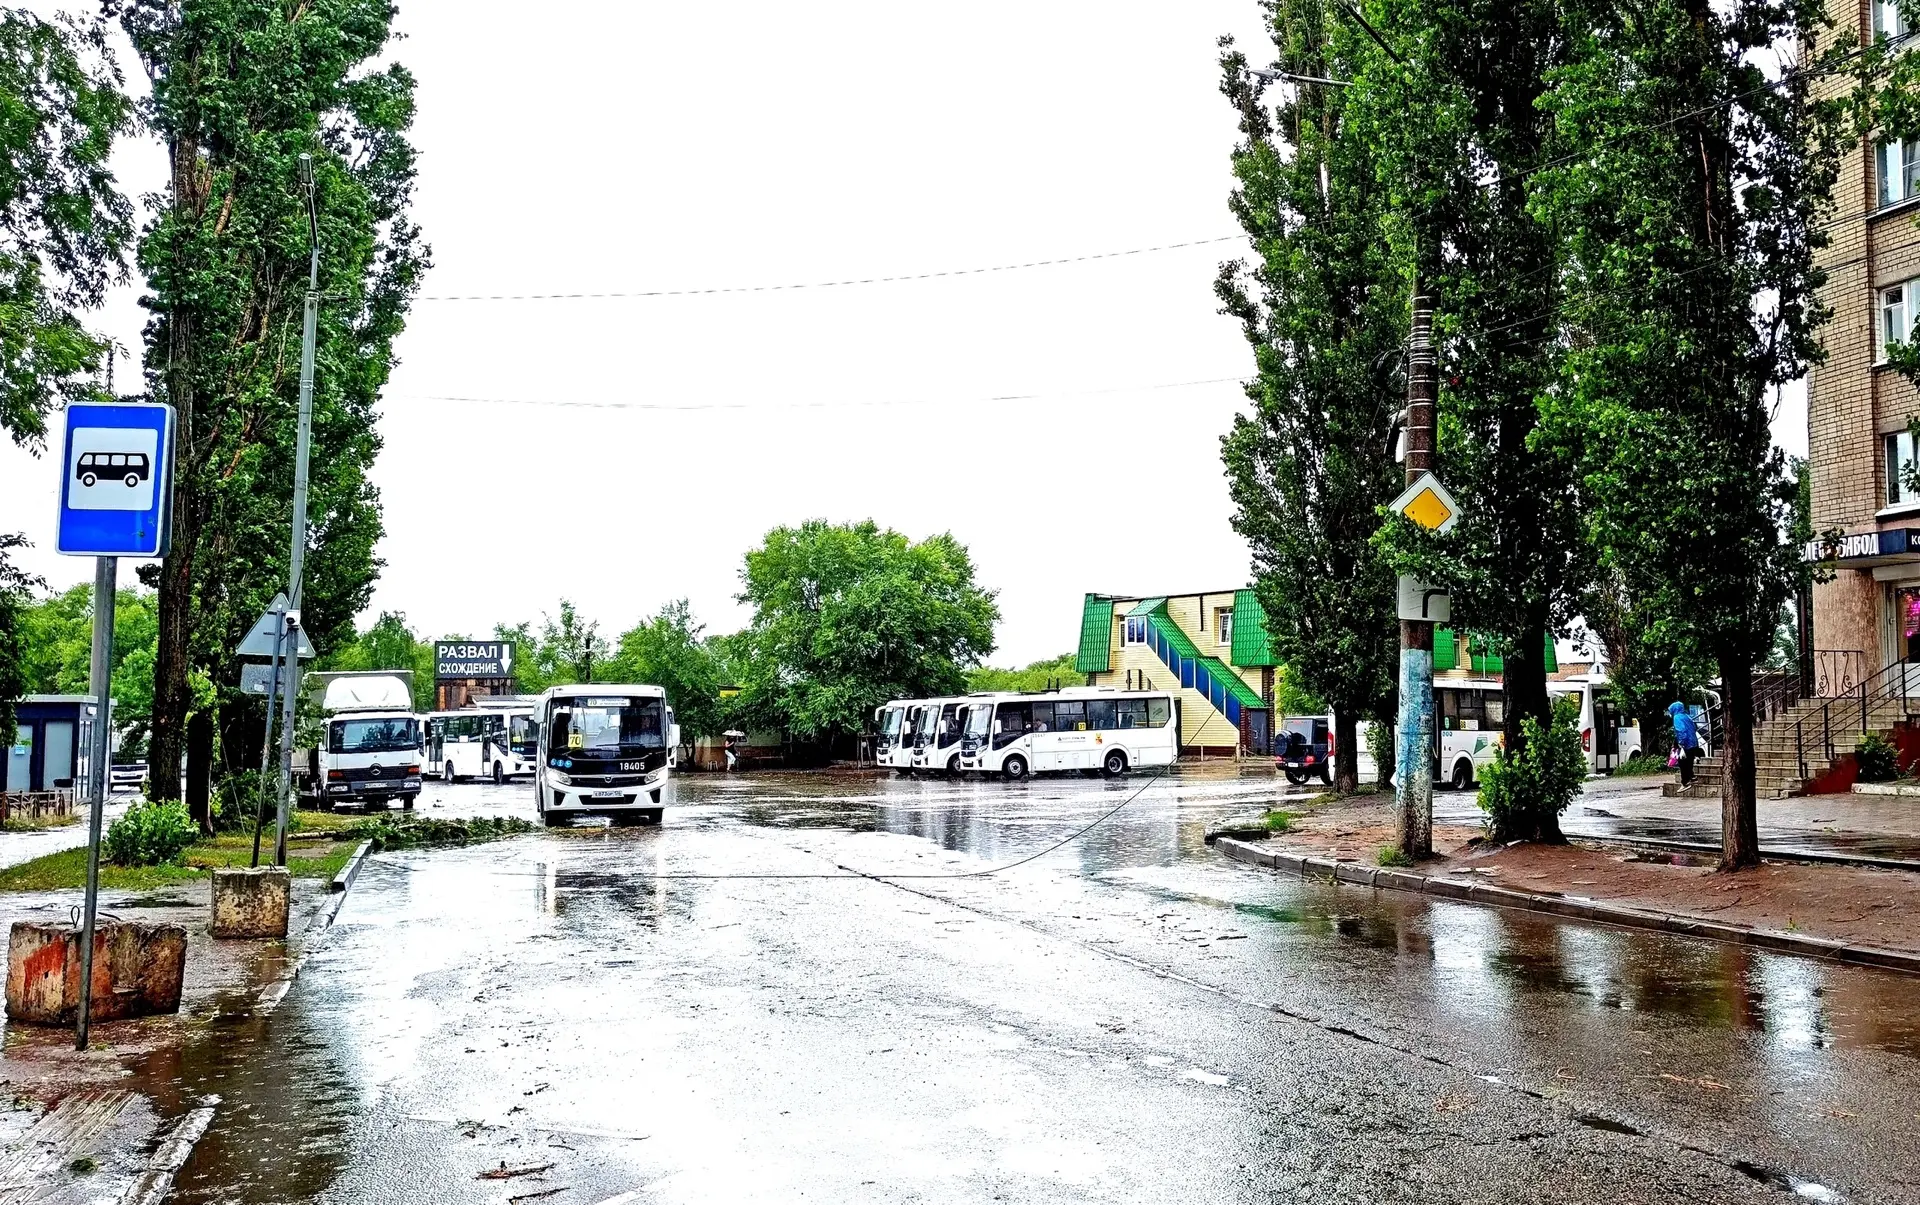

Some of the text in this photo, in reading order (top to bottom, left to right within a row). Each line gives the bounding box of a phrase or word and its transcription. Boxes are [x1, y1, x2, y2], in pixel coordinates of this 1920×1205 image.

[1797, 533, 1880, 562] ЛЕБЗАВОД
[438, 645, 498, 659] РАЗВАЛ
[438, 662, 498, 675] СХОЖДЕНИЕ
[569, 735, 581, 746] 70
[619, 762, 645, 771] 18405
